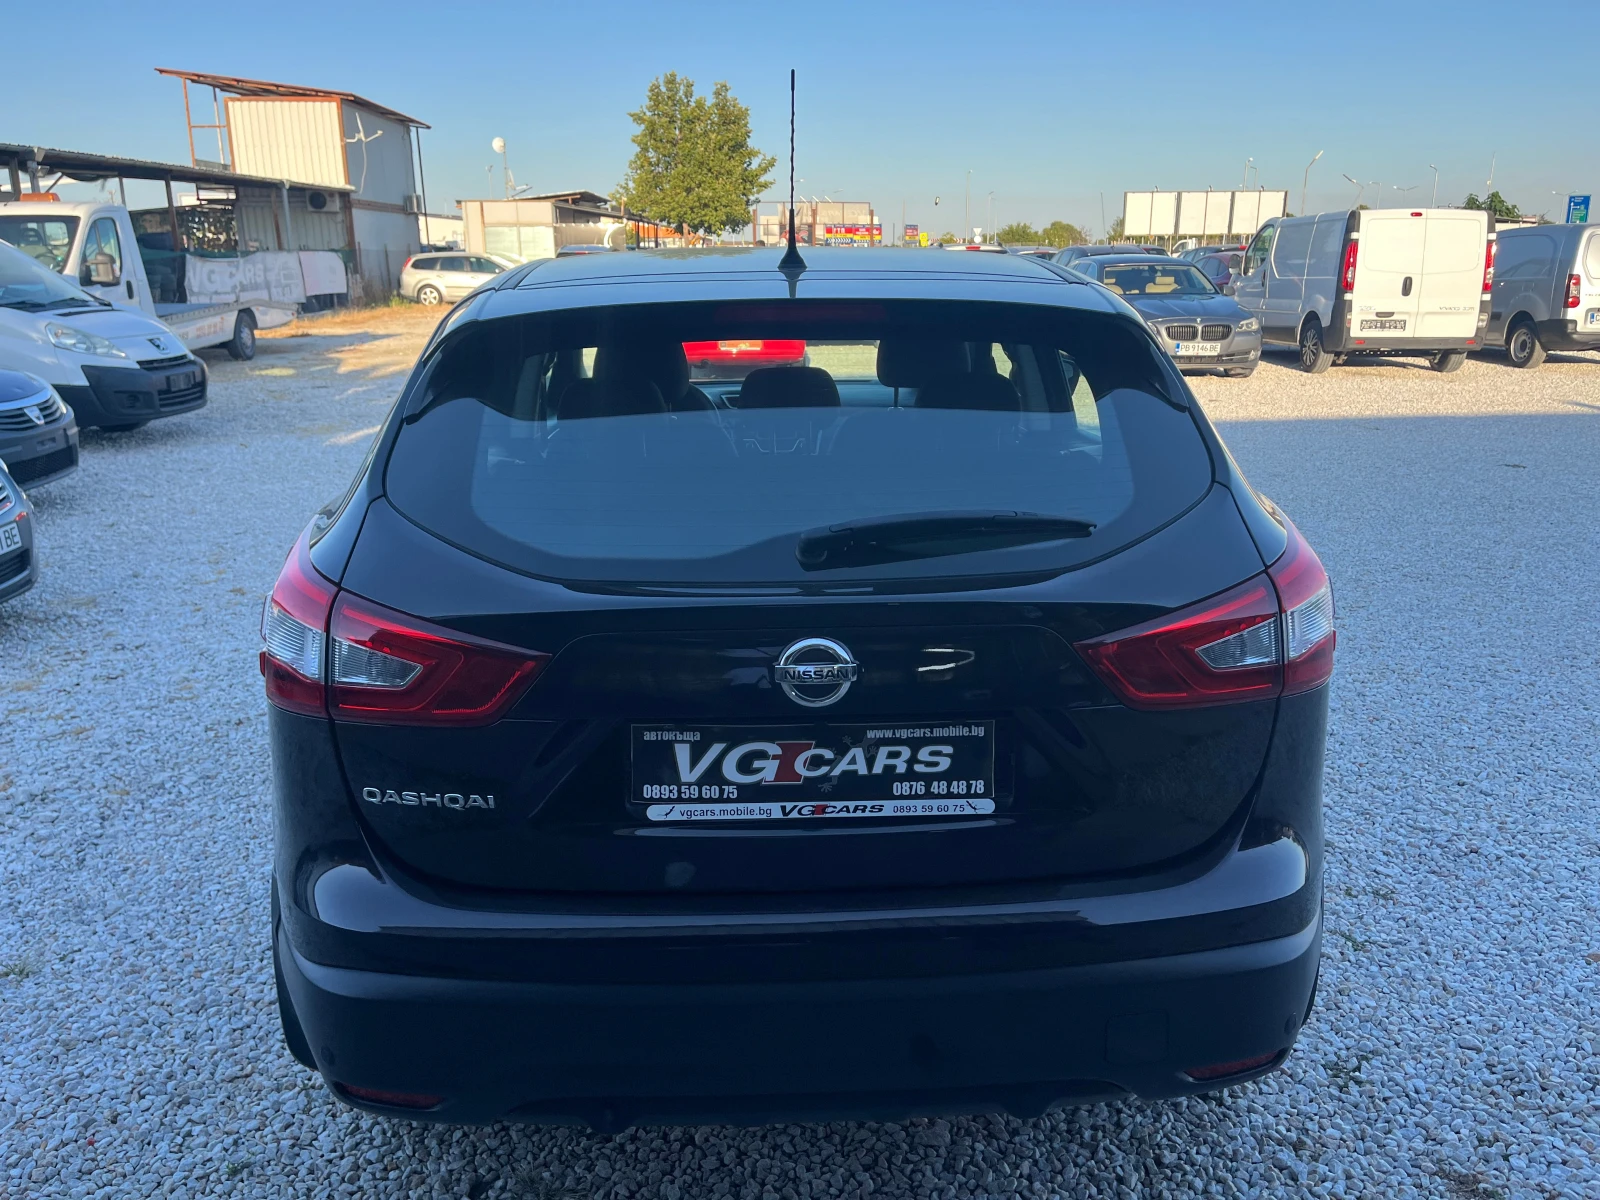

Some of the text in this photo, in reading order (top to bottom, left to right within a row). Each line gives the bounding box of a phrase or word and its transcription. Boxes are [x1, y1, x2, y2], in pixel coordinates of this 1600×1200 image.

[1191, 344, 1209, 352] 9146
[1209, 344, 1219, 352] BE
[3, 526, 19, 548] BE
[784, 669, 848, 680] NISSAN
[643, 731, 700, 741] автокъща
[866, 725, 985, 739] www.vgcars.mobile.bg
[643, 784, 738, 799] 0893 59 60 75
[892, 779, 985, 796] 0876 48 48 78
[362, 787, 496, 810] QASHQAI
[679, 805, 772, 819] vgcars.mobile.bg
[892, 805, 918, 813] 0893
[921, 804, 934, 813] 59
[936, 804, 949, 813] 60
[952, 804, 965, 813] 75
